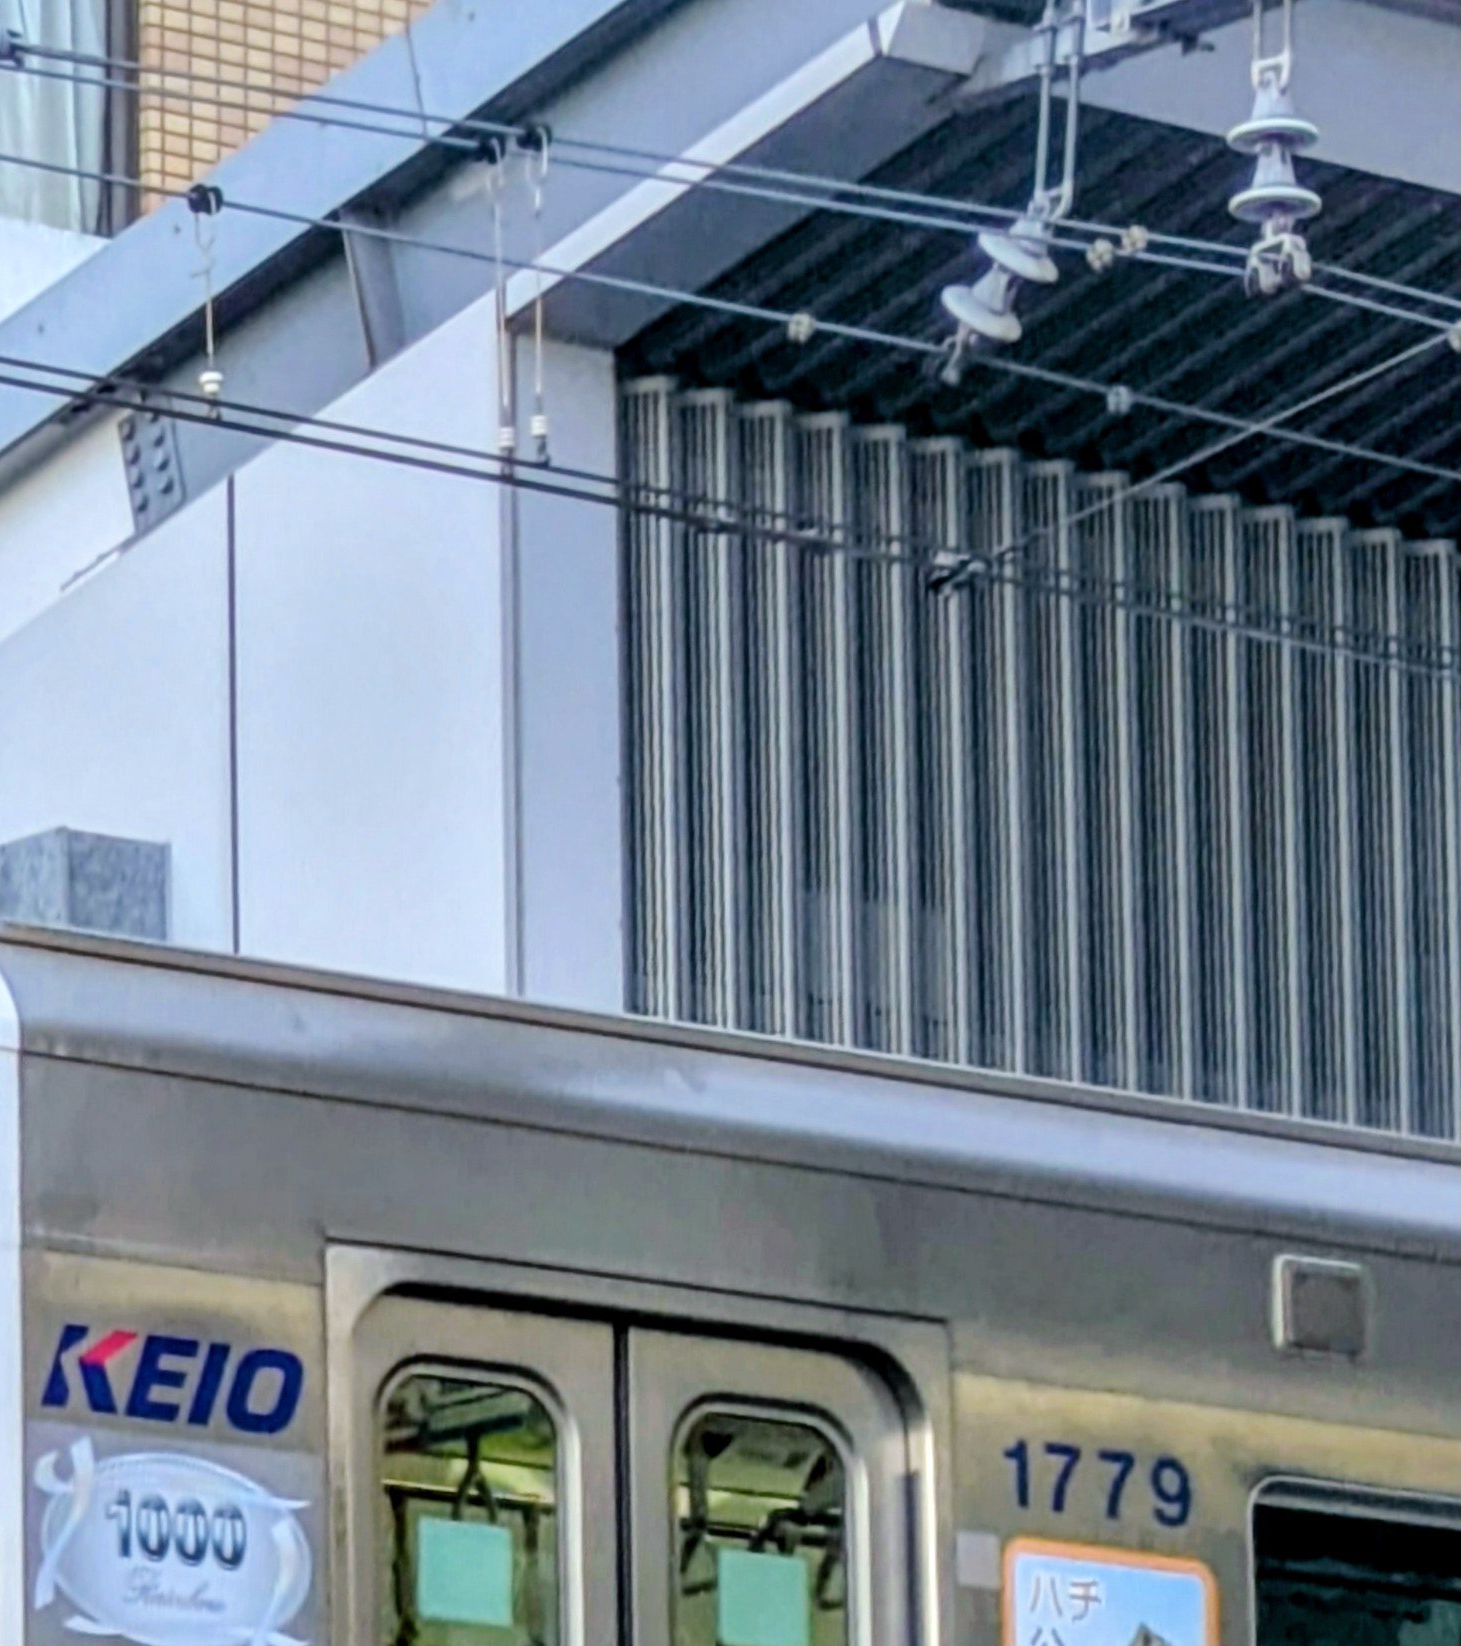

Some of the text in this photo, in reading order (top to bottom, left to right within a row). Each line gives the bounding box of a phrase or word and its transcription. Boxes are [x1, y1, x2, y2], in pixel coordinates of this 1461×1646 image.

[40, 1323, 305, 1435] KEIO
[1003, 1439, 1192, 1528] 1779
[104, 1488, 248, 1572] 1000
[1029, 1573, 1102, 1622] ハチ
